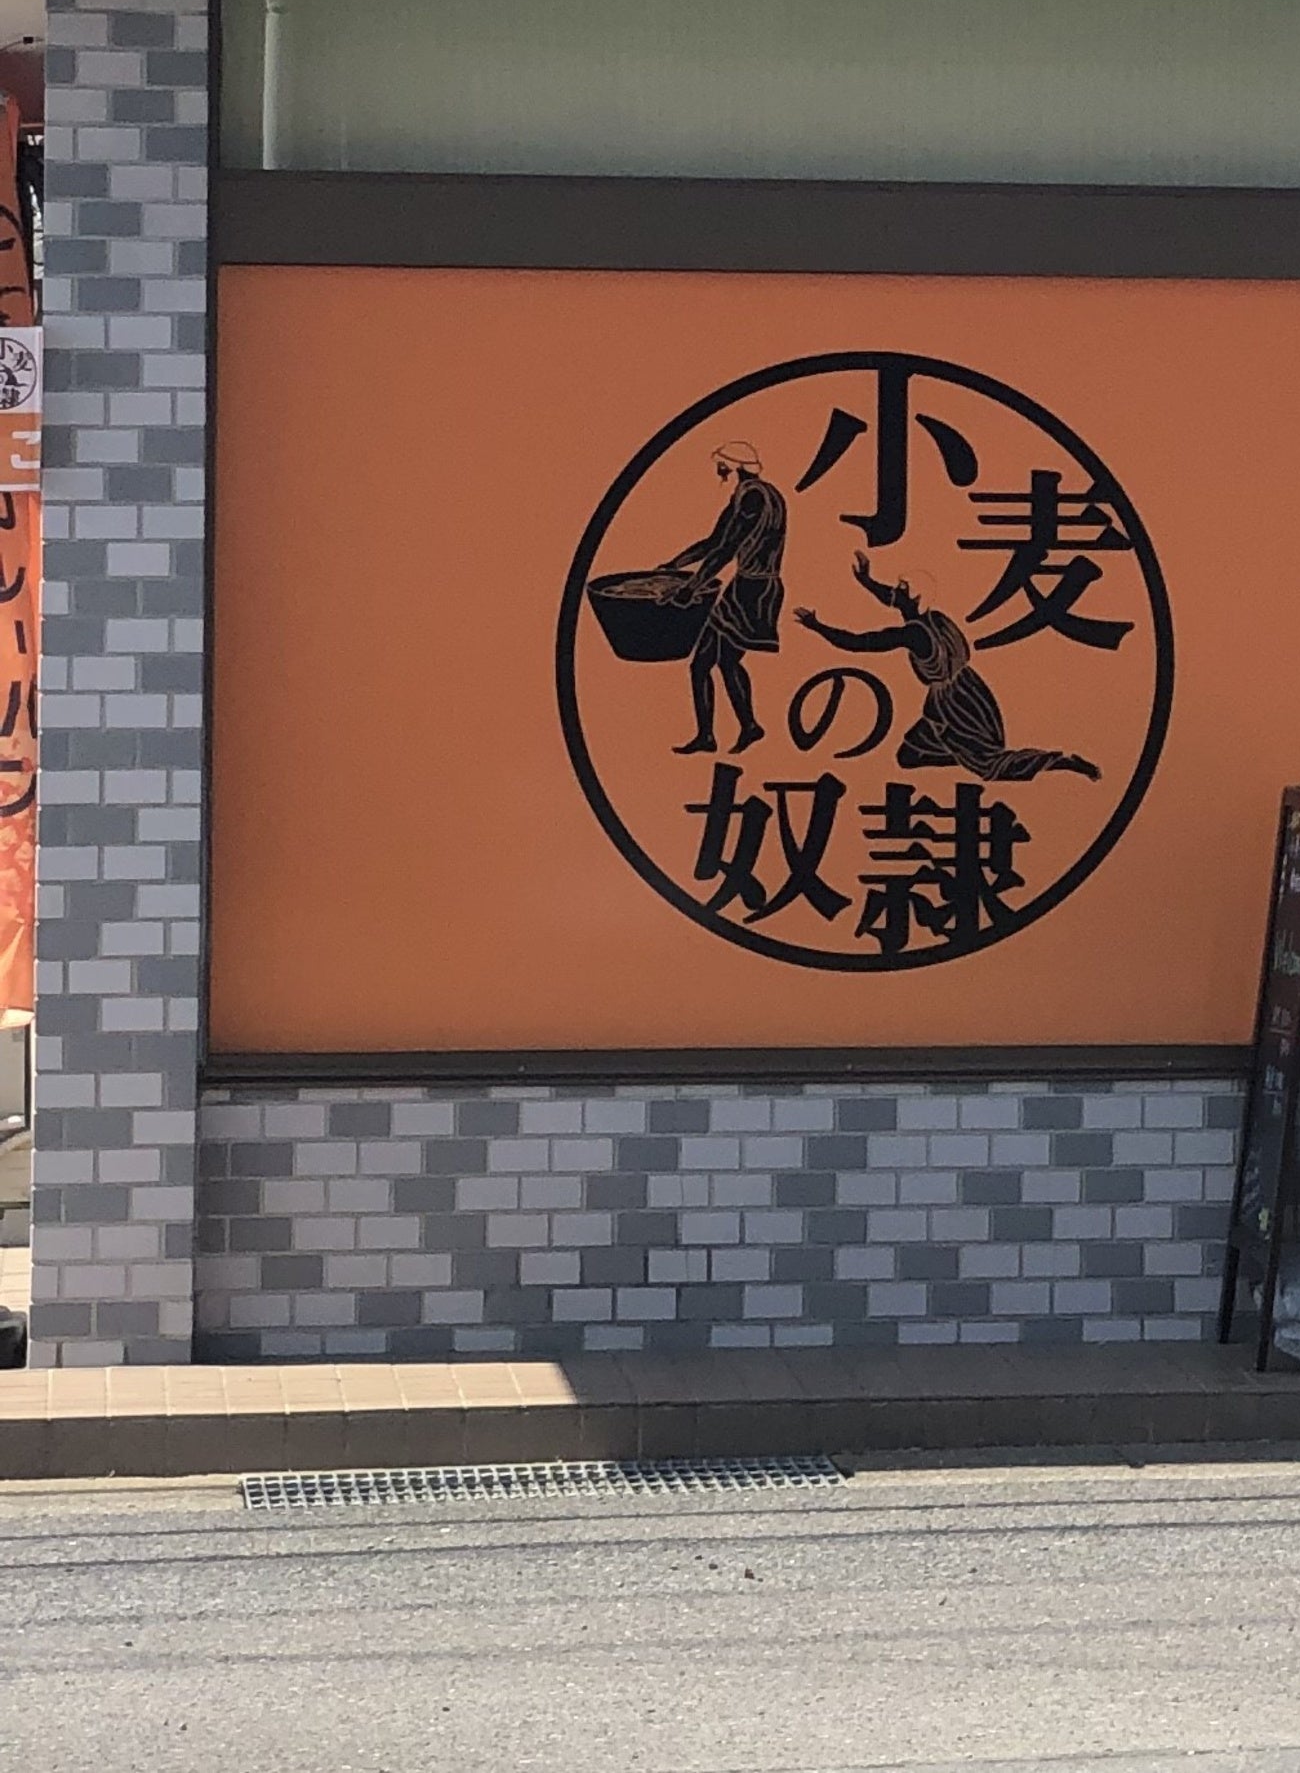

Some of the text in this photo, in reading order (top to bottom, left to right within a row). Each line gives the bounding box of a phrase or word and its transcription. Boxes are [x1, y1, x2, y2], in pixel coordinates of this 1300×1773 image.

[793, 366, 1136, 652] 小麦
[787, 666, 894, 760] の
[684, 761, 1032, 955] 奴隷
